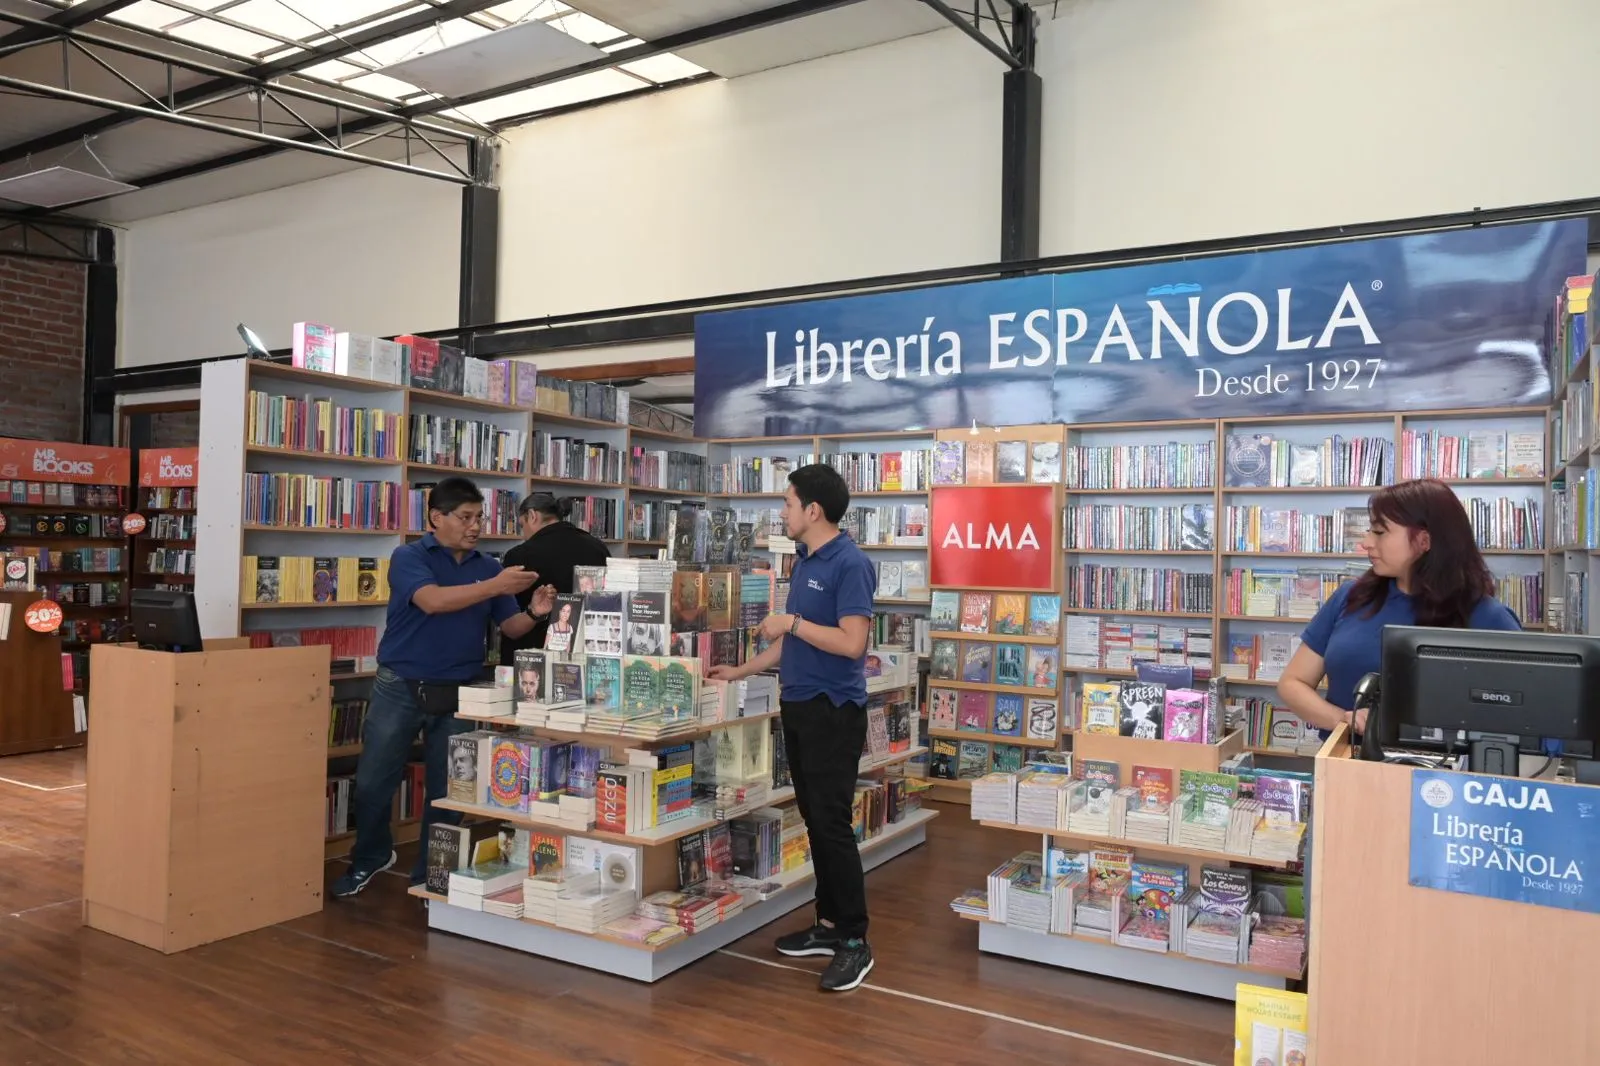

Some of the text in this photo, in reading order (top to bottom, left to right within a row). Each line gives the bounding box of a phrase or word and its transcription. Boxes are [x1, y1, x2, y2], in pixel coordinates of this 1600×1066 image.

[765, 281, 1382, 389] Librería ESPAÑOLA
[1195, 358, 1382, 399] Desde 1927
[34, 448, 60, 461] MR.
[33, 459, 94, 475] BOOKS
[159, 464, 193, 478] BOOKS
[124, 518, 146, 529] 20%
[941, 522, 1041, 550] ALMA
[26, 607, 62, 624] 20%
[1122, 686, 1163, 701] SPREEN
[1463, 780, 1554, 813] CAJA
[1432, 813, 1524, 846] Librería
[534, 835, 558, 847] ISABEL
[532, 844, 561, 857] ALLENDE
[1446, 843, 1584, 882] ESPAÑOLA
[1522, 876, 1584, 895] Desde 1927
